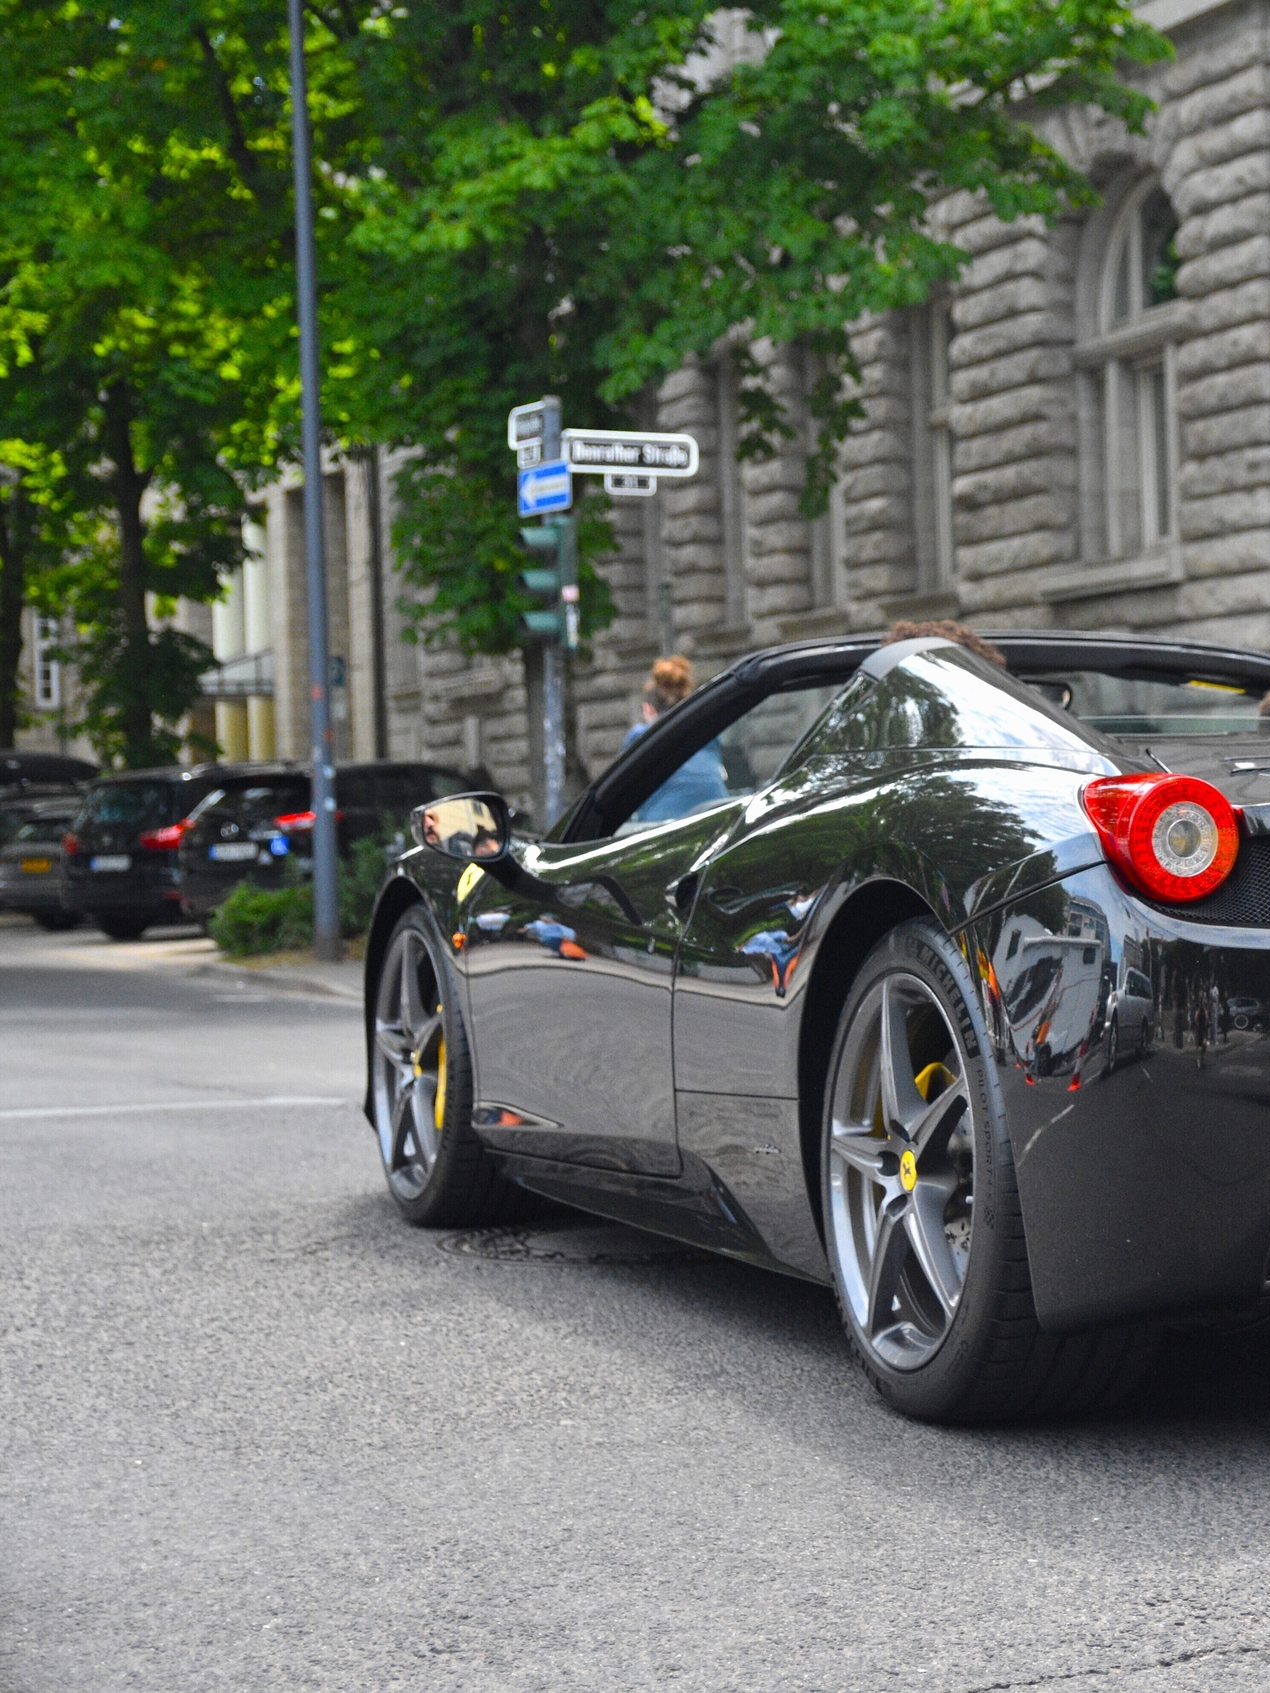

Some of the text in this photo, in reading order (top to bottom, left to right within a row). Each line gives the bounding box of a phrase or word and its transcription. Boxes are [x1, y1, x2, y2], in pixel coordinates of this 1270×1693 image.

[920, 944, 977, 1050] MICHELIN
[976, 1069, 988, 1111] PILOT
[984, 1121, 993, 1176] SPORT
